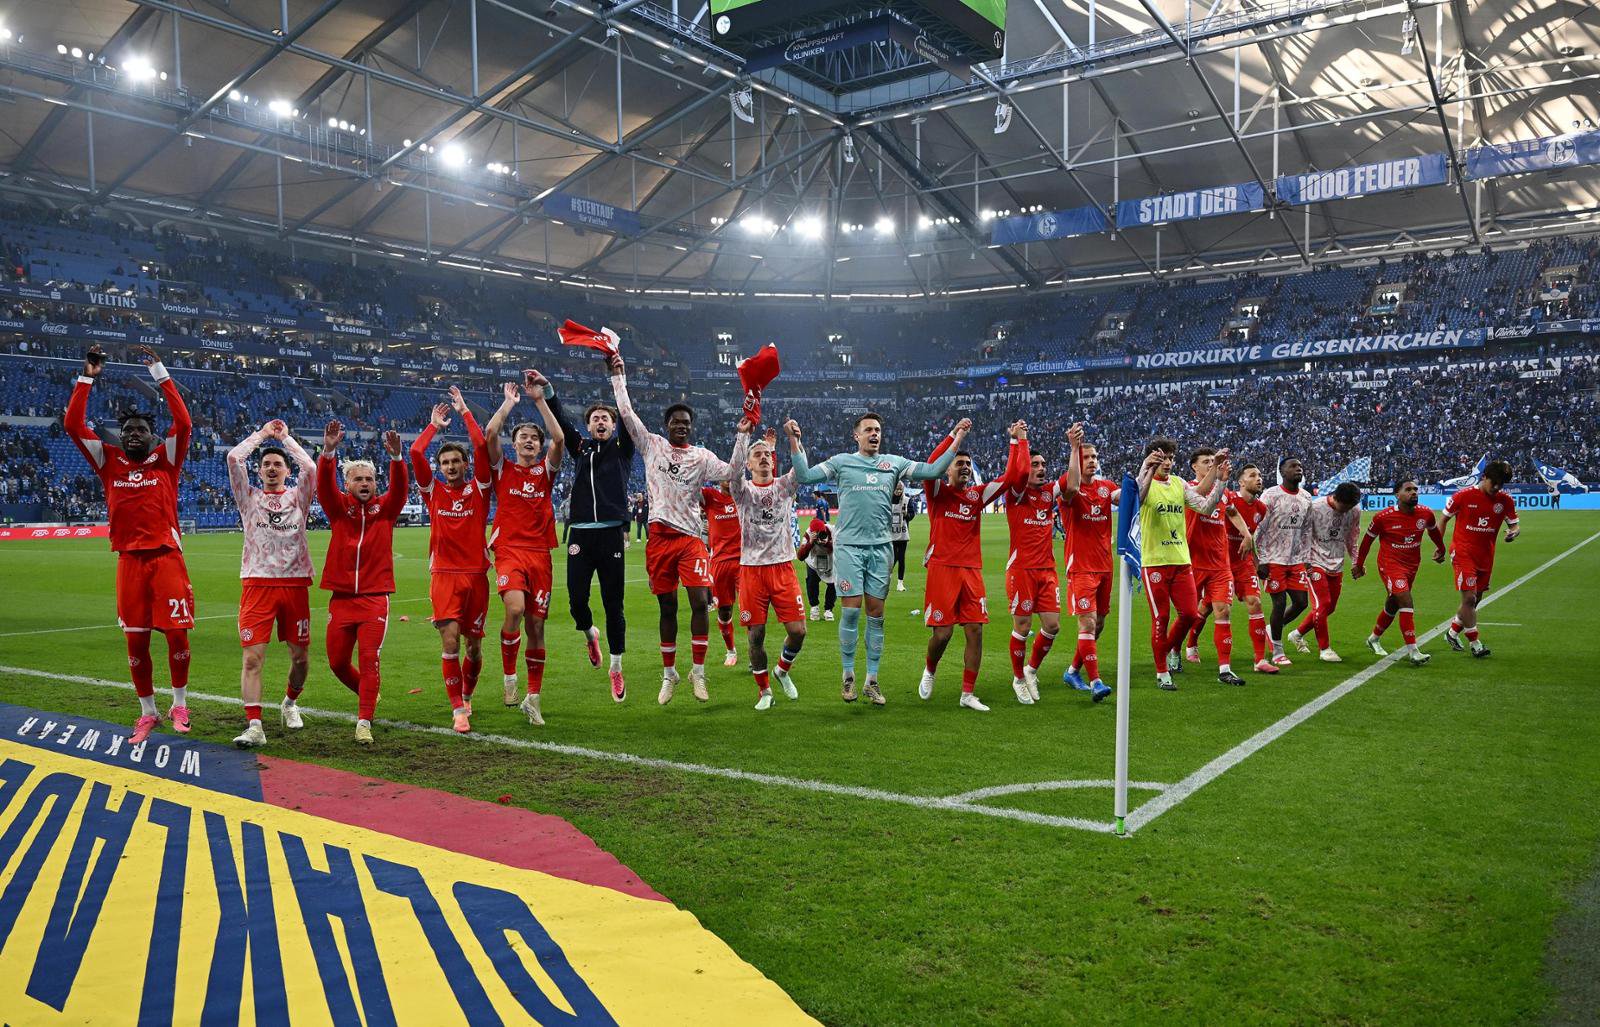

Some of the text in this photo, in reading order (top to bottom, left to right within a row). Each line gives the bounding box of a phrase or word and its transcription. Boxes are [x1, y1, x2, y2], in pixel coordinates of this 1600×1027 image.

[792, 32, 845, 51] KNAPPSCHAFT
[793, 47, 826, 60] KLINIKEN
[1299, 158, 1420, 201] 1000 FEUER
[571, 198, 615, 219] #STEHTAUF
[1139, 186, 1237, 223] STADT DER
[90, 292, 137, 308] VELTINS
[162, 302, 199, 315] Vontobel
[340, 325, 371, 336] Stölting
[201, 339, 234, 349] TÖNNIES
[1136, 329, 1464, 368] NORDKURVE GELSENKIRCHEN
[441, 363, 458, 372] AVG
[113, 478, 159, 488] Kömmerling
[1166, 505, 1183, 514] JAKO
[1512, 495, 1559, 508] GROU
[168, 598, 189, 618] 21
[796, 594, 803, 611] 9
[473, 612, 483, 627] 4
[296, 619, 309, 637] 19
[17, 717, 201, 777] WORKWEAR
